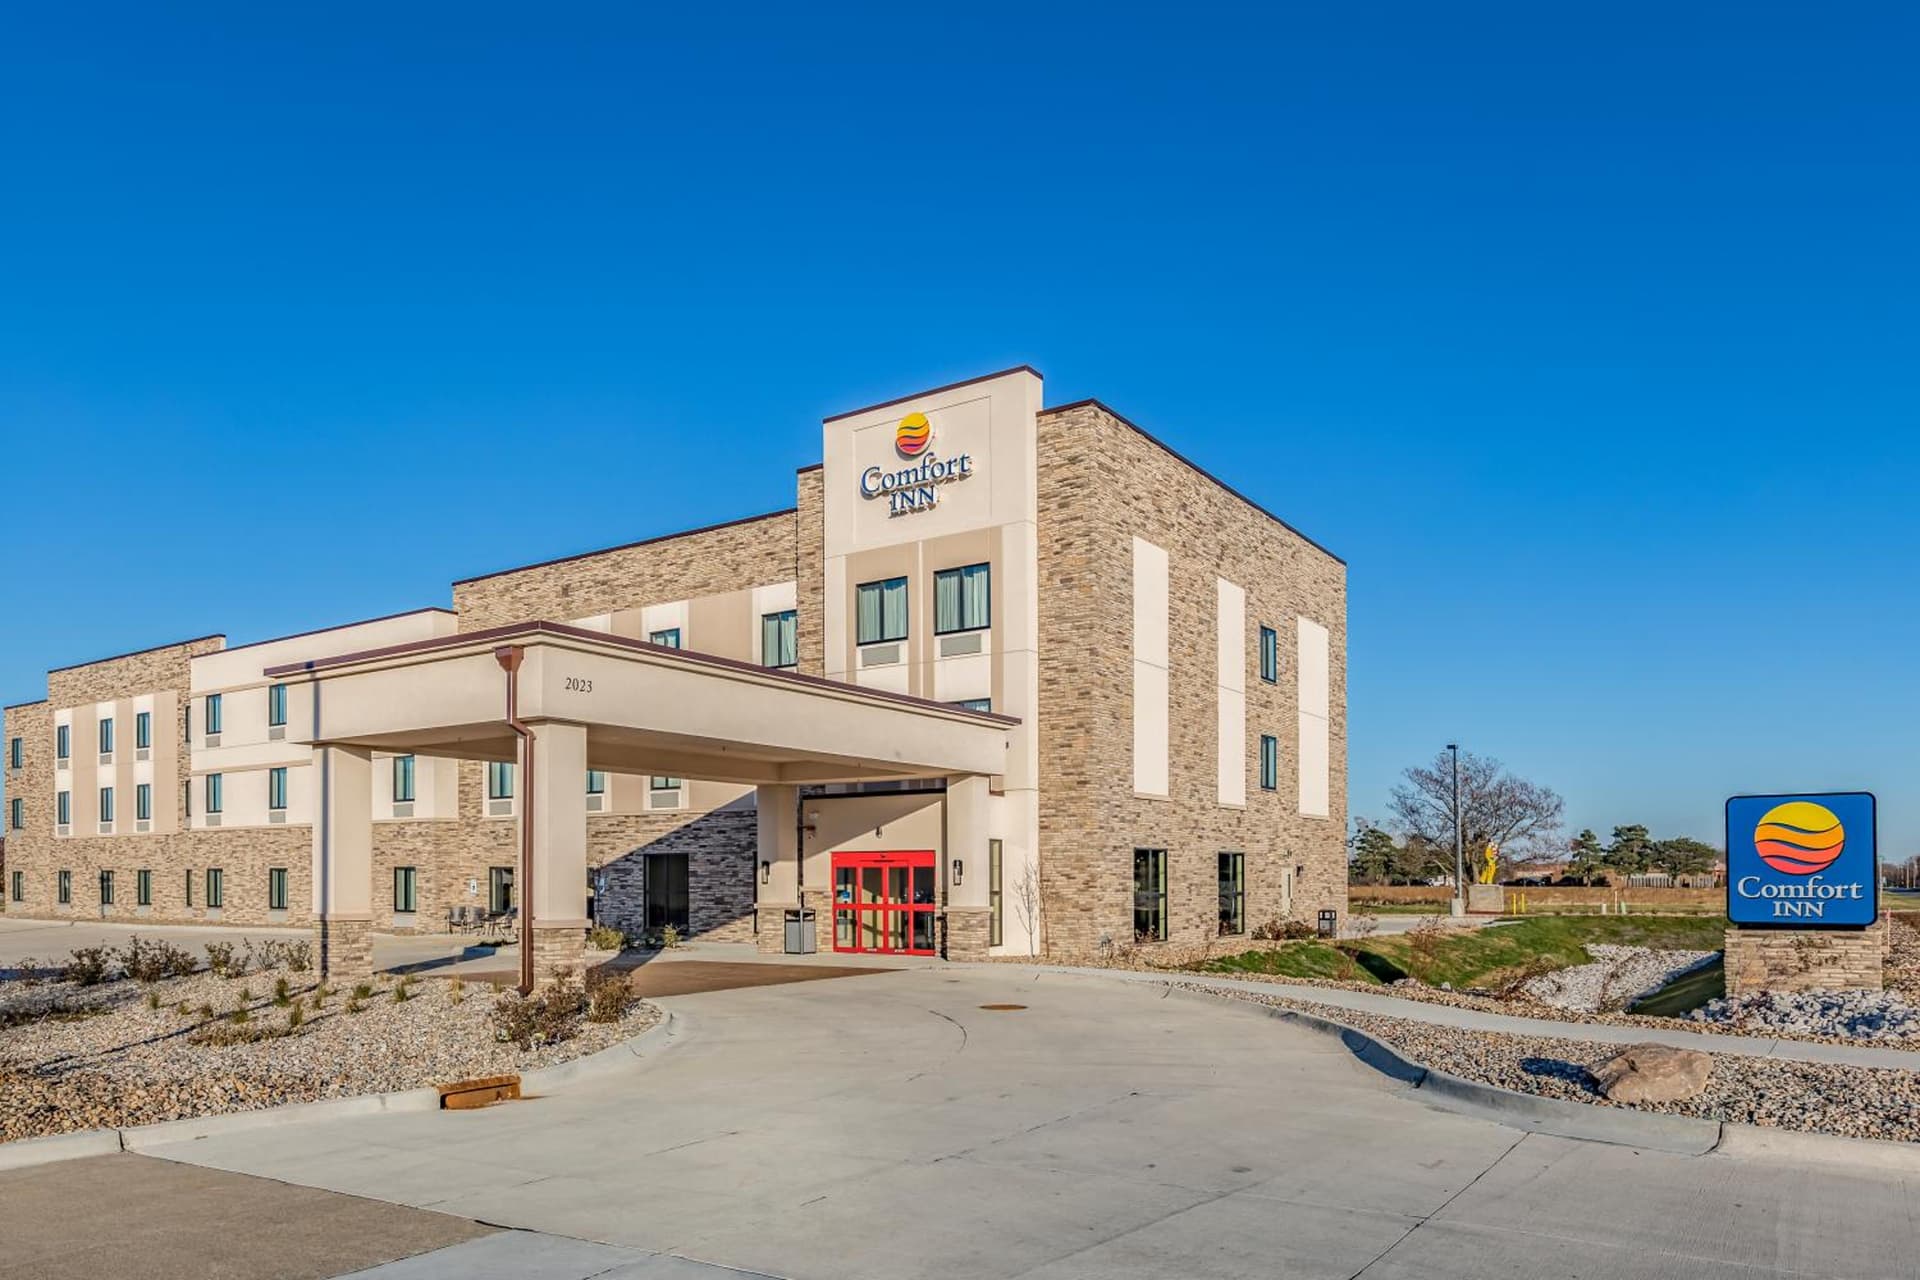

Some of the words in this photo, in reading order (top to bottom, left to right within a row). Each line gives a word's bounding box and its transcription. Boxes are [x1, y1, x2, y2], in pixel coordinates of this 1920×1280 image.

[862, 453, 970, 493] Comfort
[890, 486, 935, 511] INN
[565, 676, 592, 693] 2023
[1738, 876, 1863, 899] Comfort
[1773, 902, 1824, 917] INN
